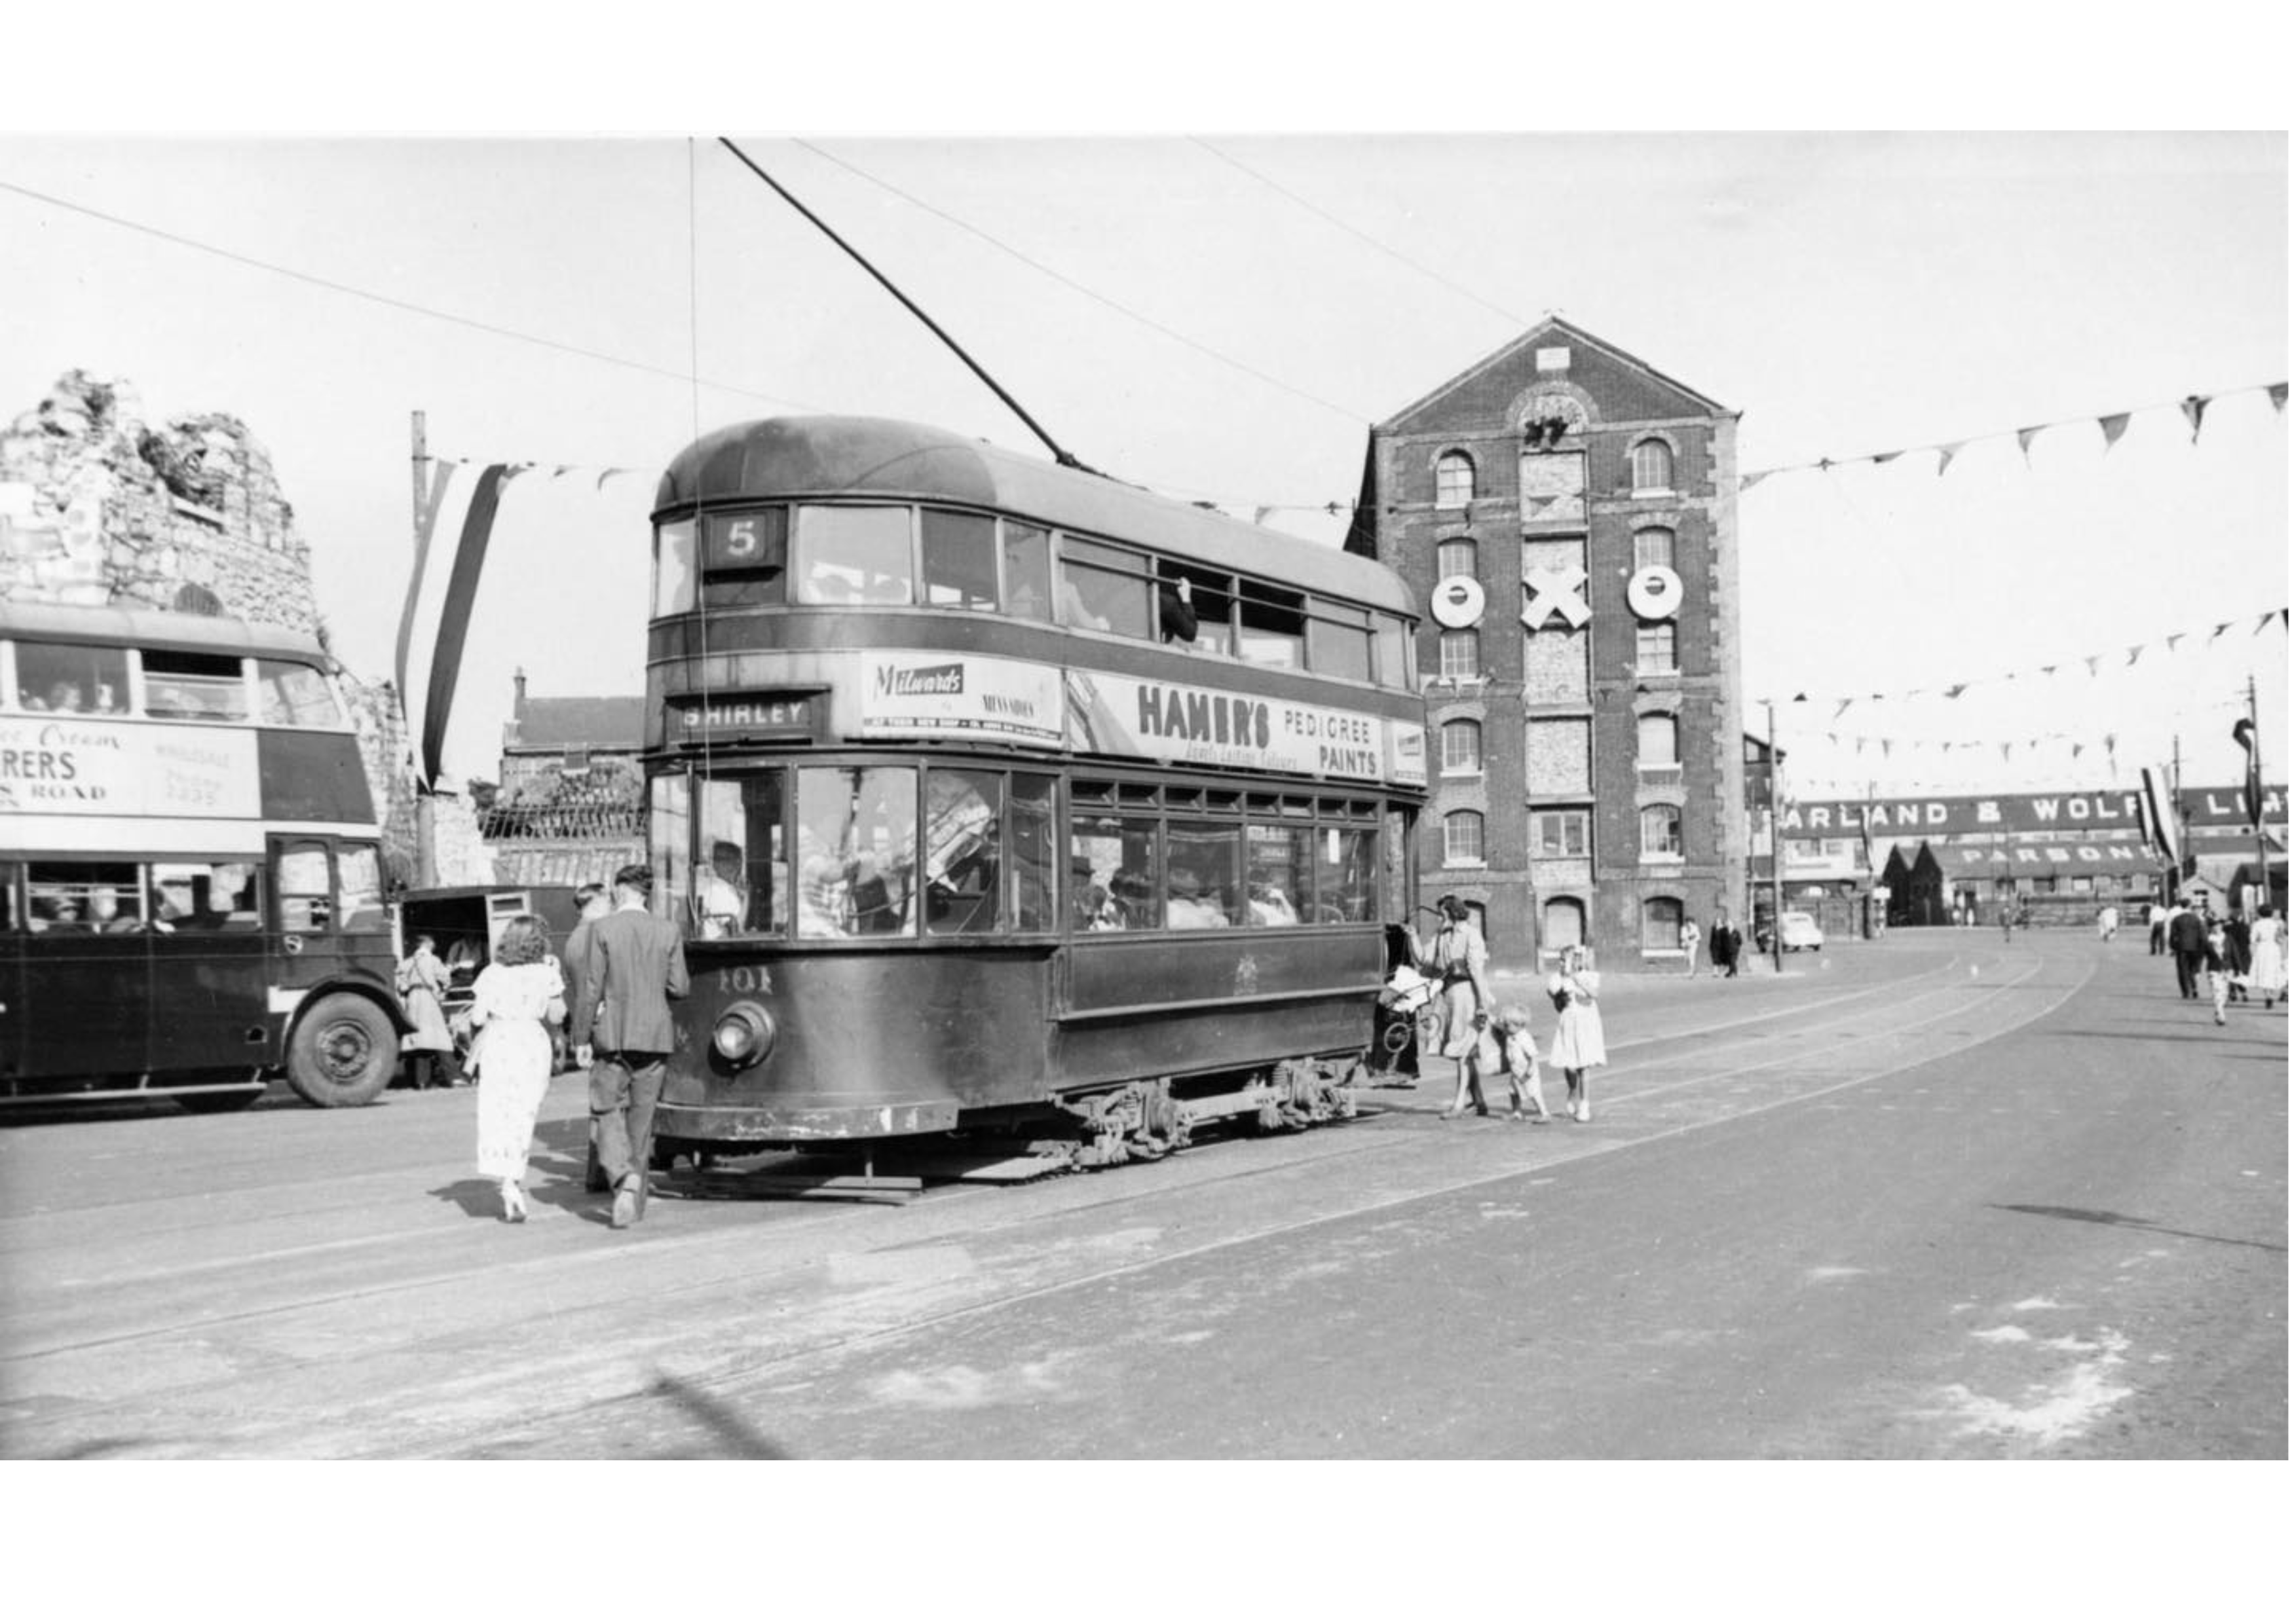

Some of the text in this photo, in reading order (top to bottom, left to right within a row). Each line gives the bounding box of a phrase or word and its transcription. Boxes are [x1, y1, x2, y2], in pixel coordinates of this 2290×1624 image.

[728, 521, 755, 556] 5
[1431, 565, 1683, 630] OXO
[874, 664, 961, 702] Milwards
[685, 702, 802, 725] SHIRLEY
[1139, 685, 1269, 749] HAMER'S
[1285, 710, 1369, 743] PEDIGREE
[39, 722, 120, 750] Cream
[1320, 745, 1376, 774] PAINTS
[32, 785, 106, 800] ROAD
[1978, 800, 2000, 822] &
[720, 967, 772, 995] 101
